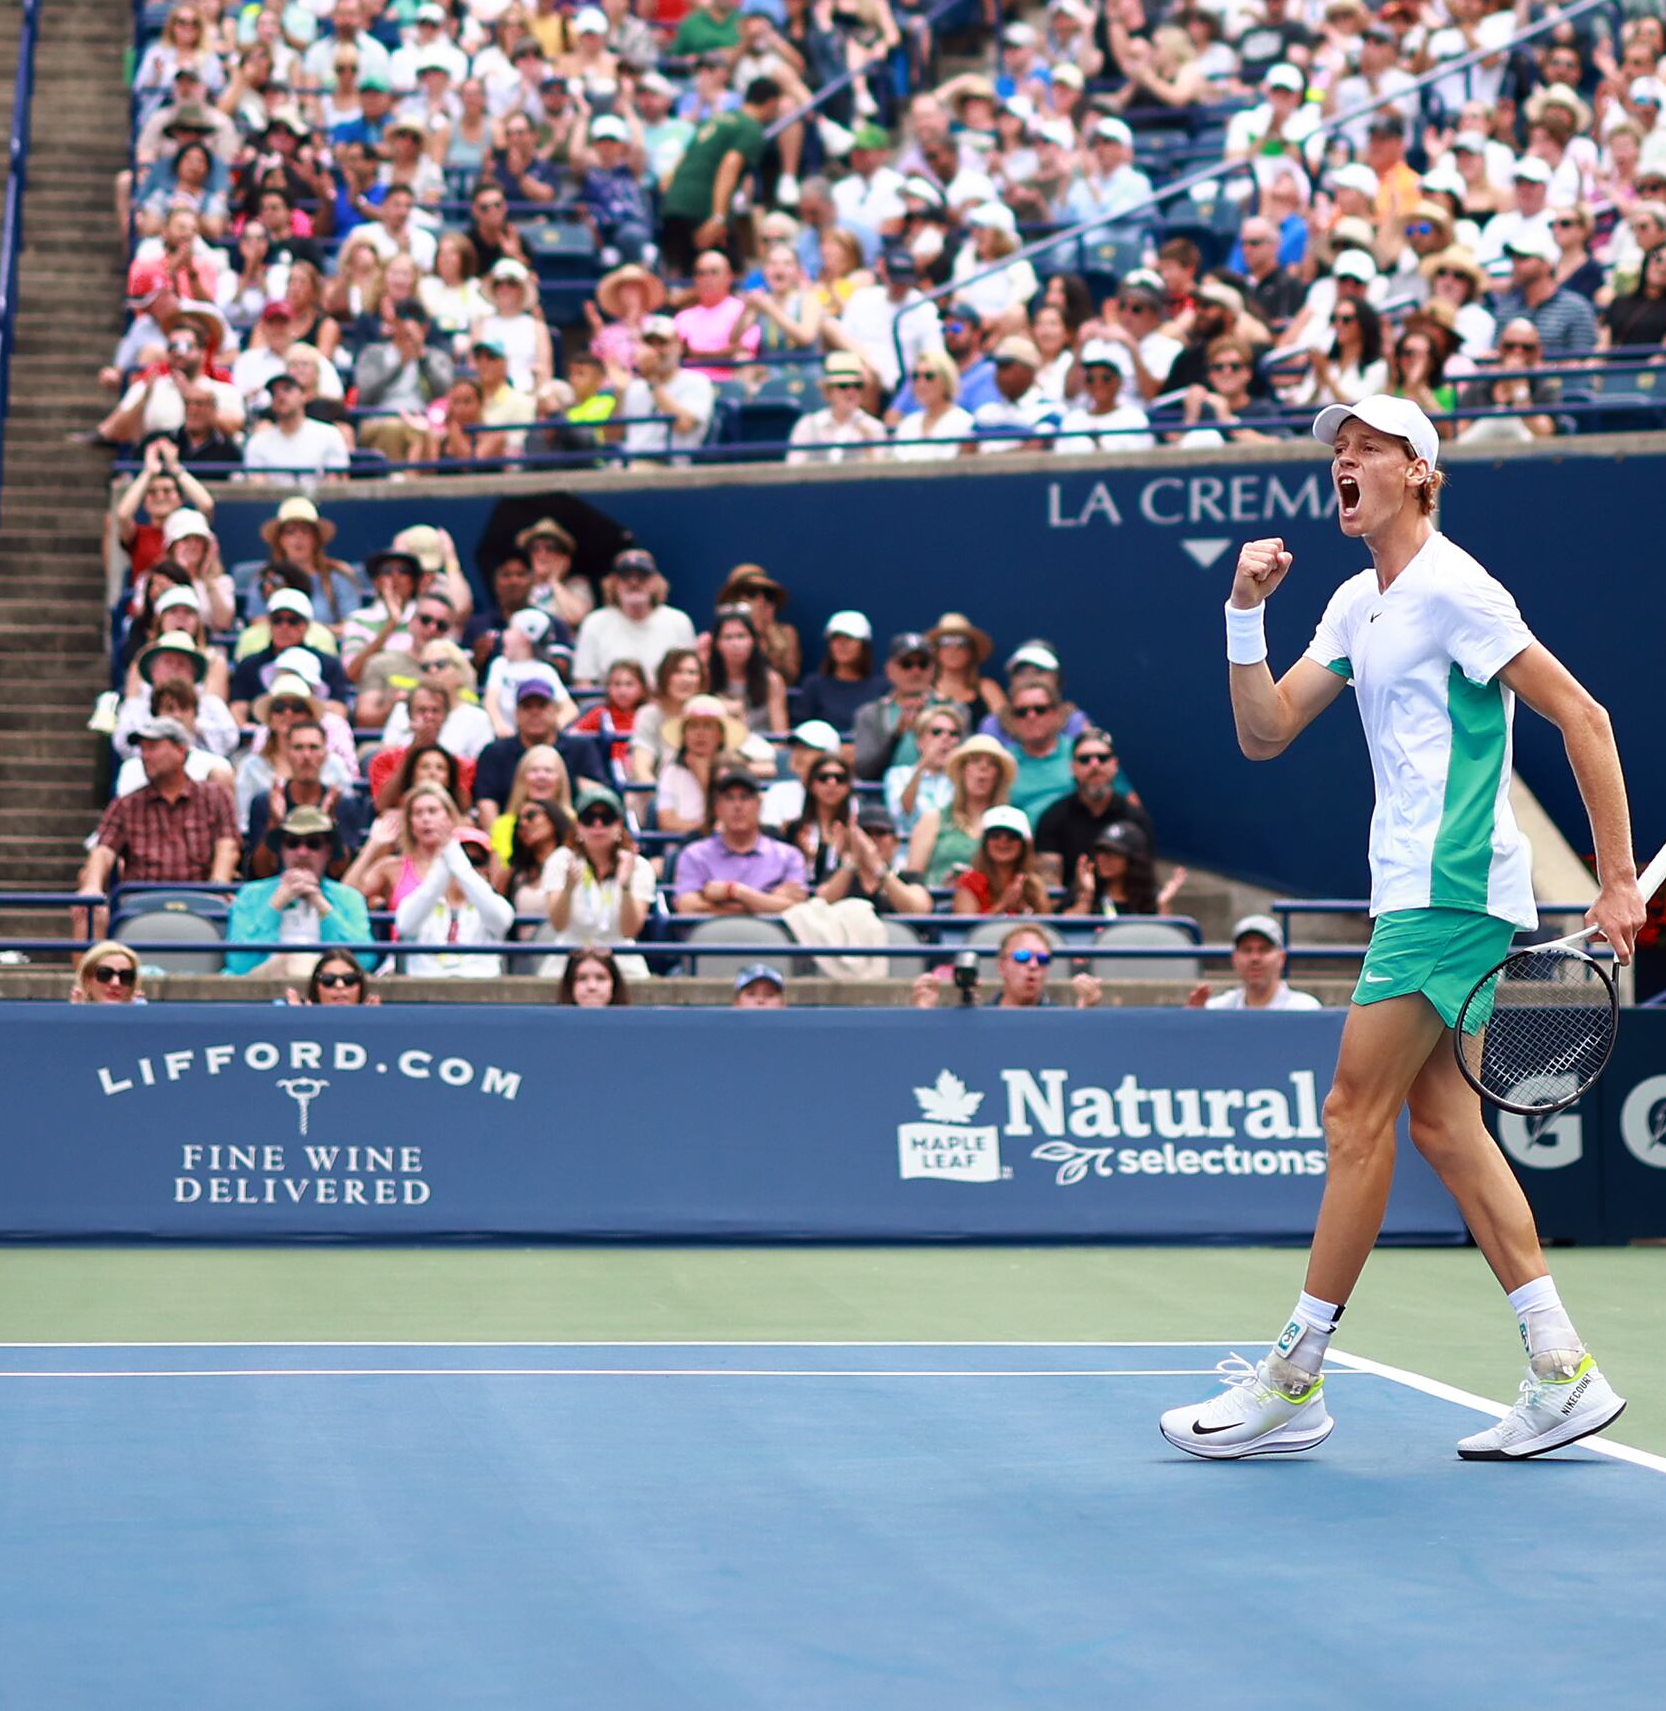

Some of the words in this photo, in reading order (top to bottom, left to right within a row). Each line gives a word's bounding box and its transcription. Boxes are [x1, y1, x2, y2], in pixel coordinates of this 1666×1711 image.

[1049, 482, 1122, 527] LA
[97, 1040, 523, 1100] LIFFORD.COM
[1001, 1068, 1324, 1139] Natural
[183, 1145, 285, 1171] FINE
[305, 1146, 423, 1172] WINE
[910, 1136, 987, 1153] MAPLE
[1117, 1142, 1327, 1175] selections
[922, 1153, 978, 1171] LEAF
[175, 1177, 432, 1205] DELIVERED
[1561, 1372, 1594, 1417] NIKECOURT
